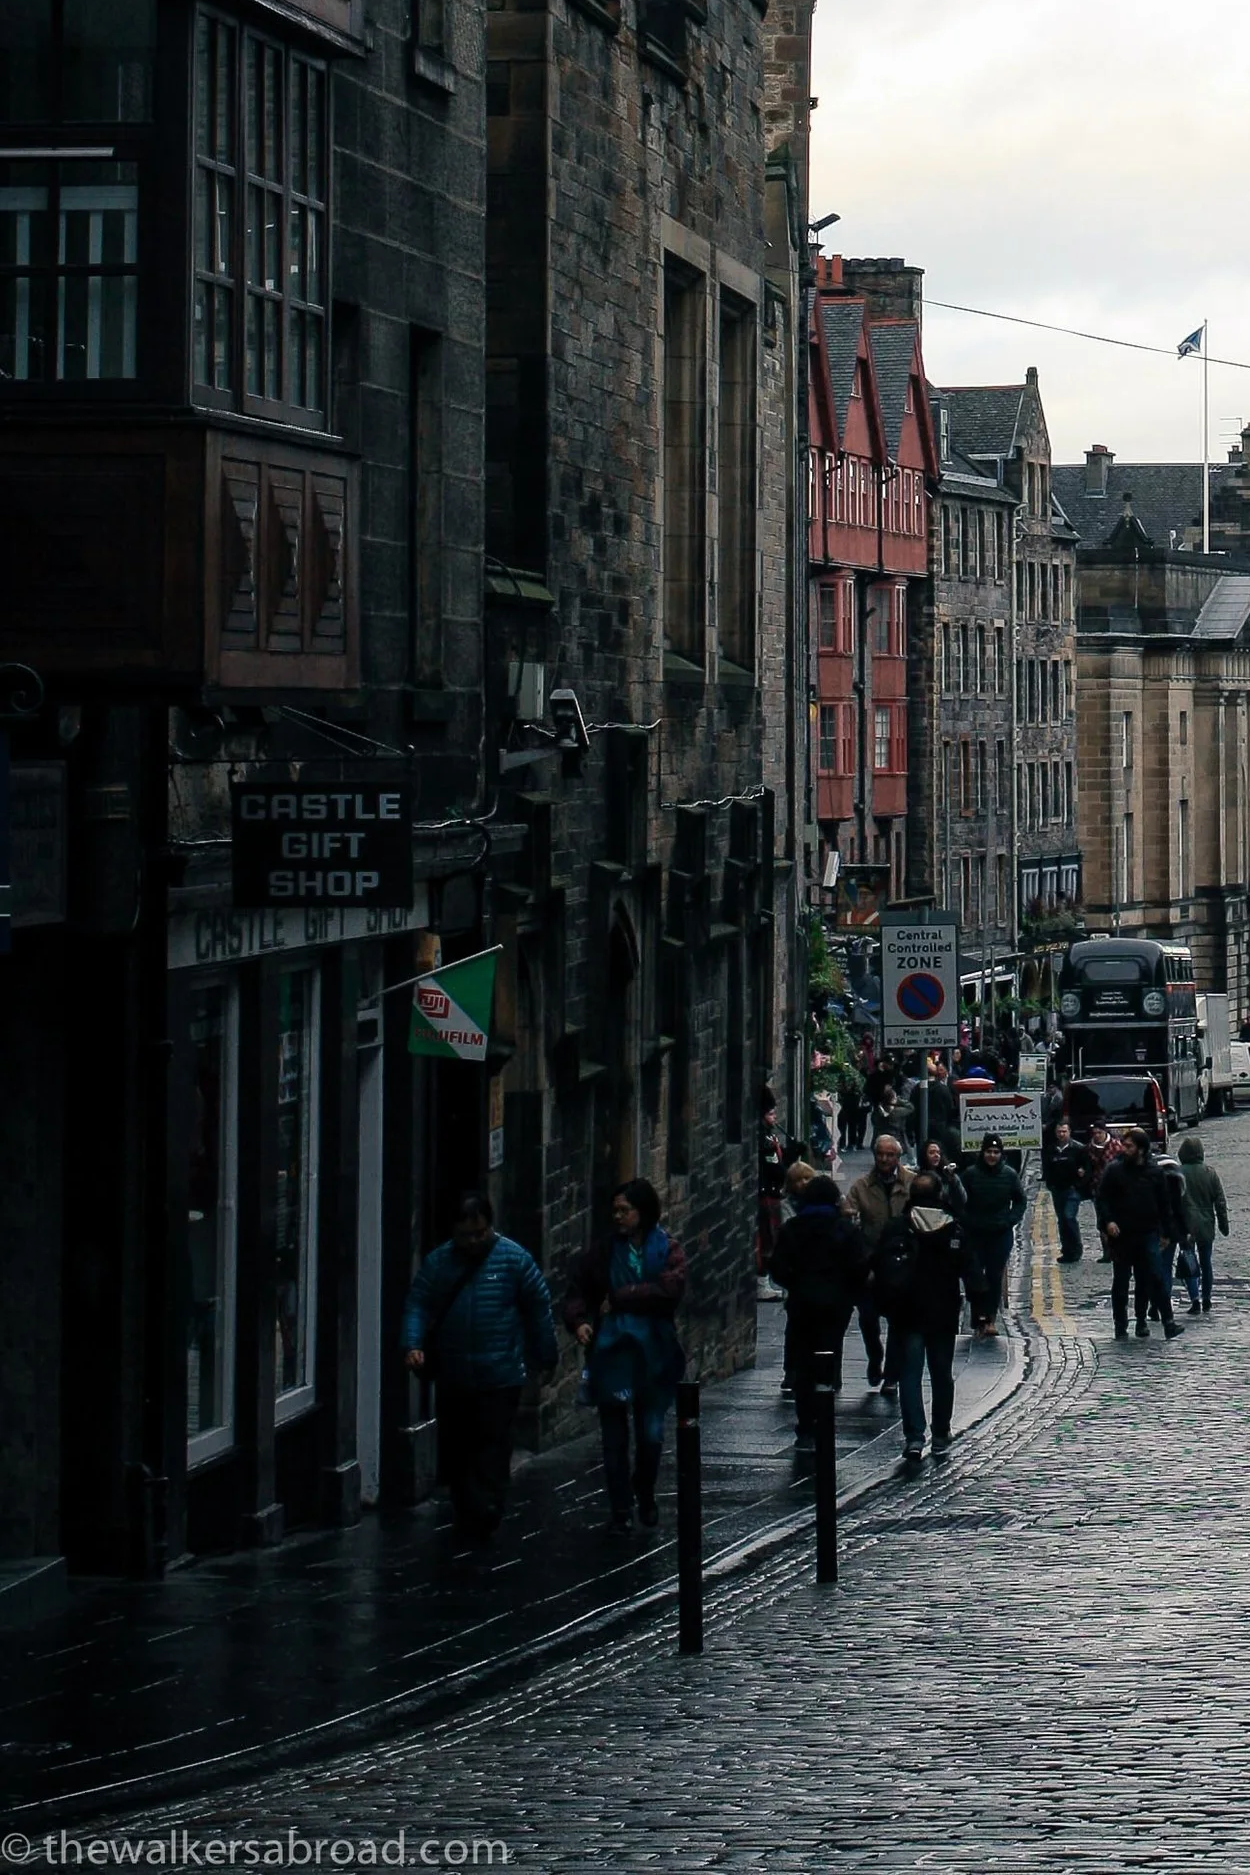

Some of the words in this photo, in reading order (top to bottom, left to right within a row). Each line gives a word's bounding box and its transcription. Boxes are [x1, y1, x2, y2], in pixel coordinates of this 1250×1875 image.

[240, 793, 401, 820] CASTLE
[281, 832, 365, 859] GIFT
[268, 870, 380, 897] SHOP
[897, 930, 942, 940] Central
[887, 942, 952, 953] Controlled
[897, 957, 942, 969] ZONE
[415, 1028, 484, 1046] FUJIFILM
